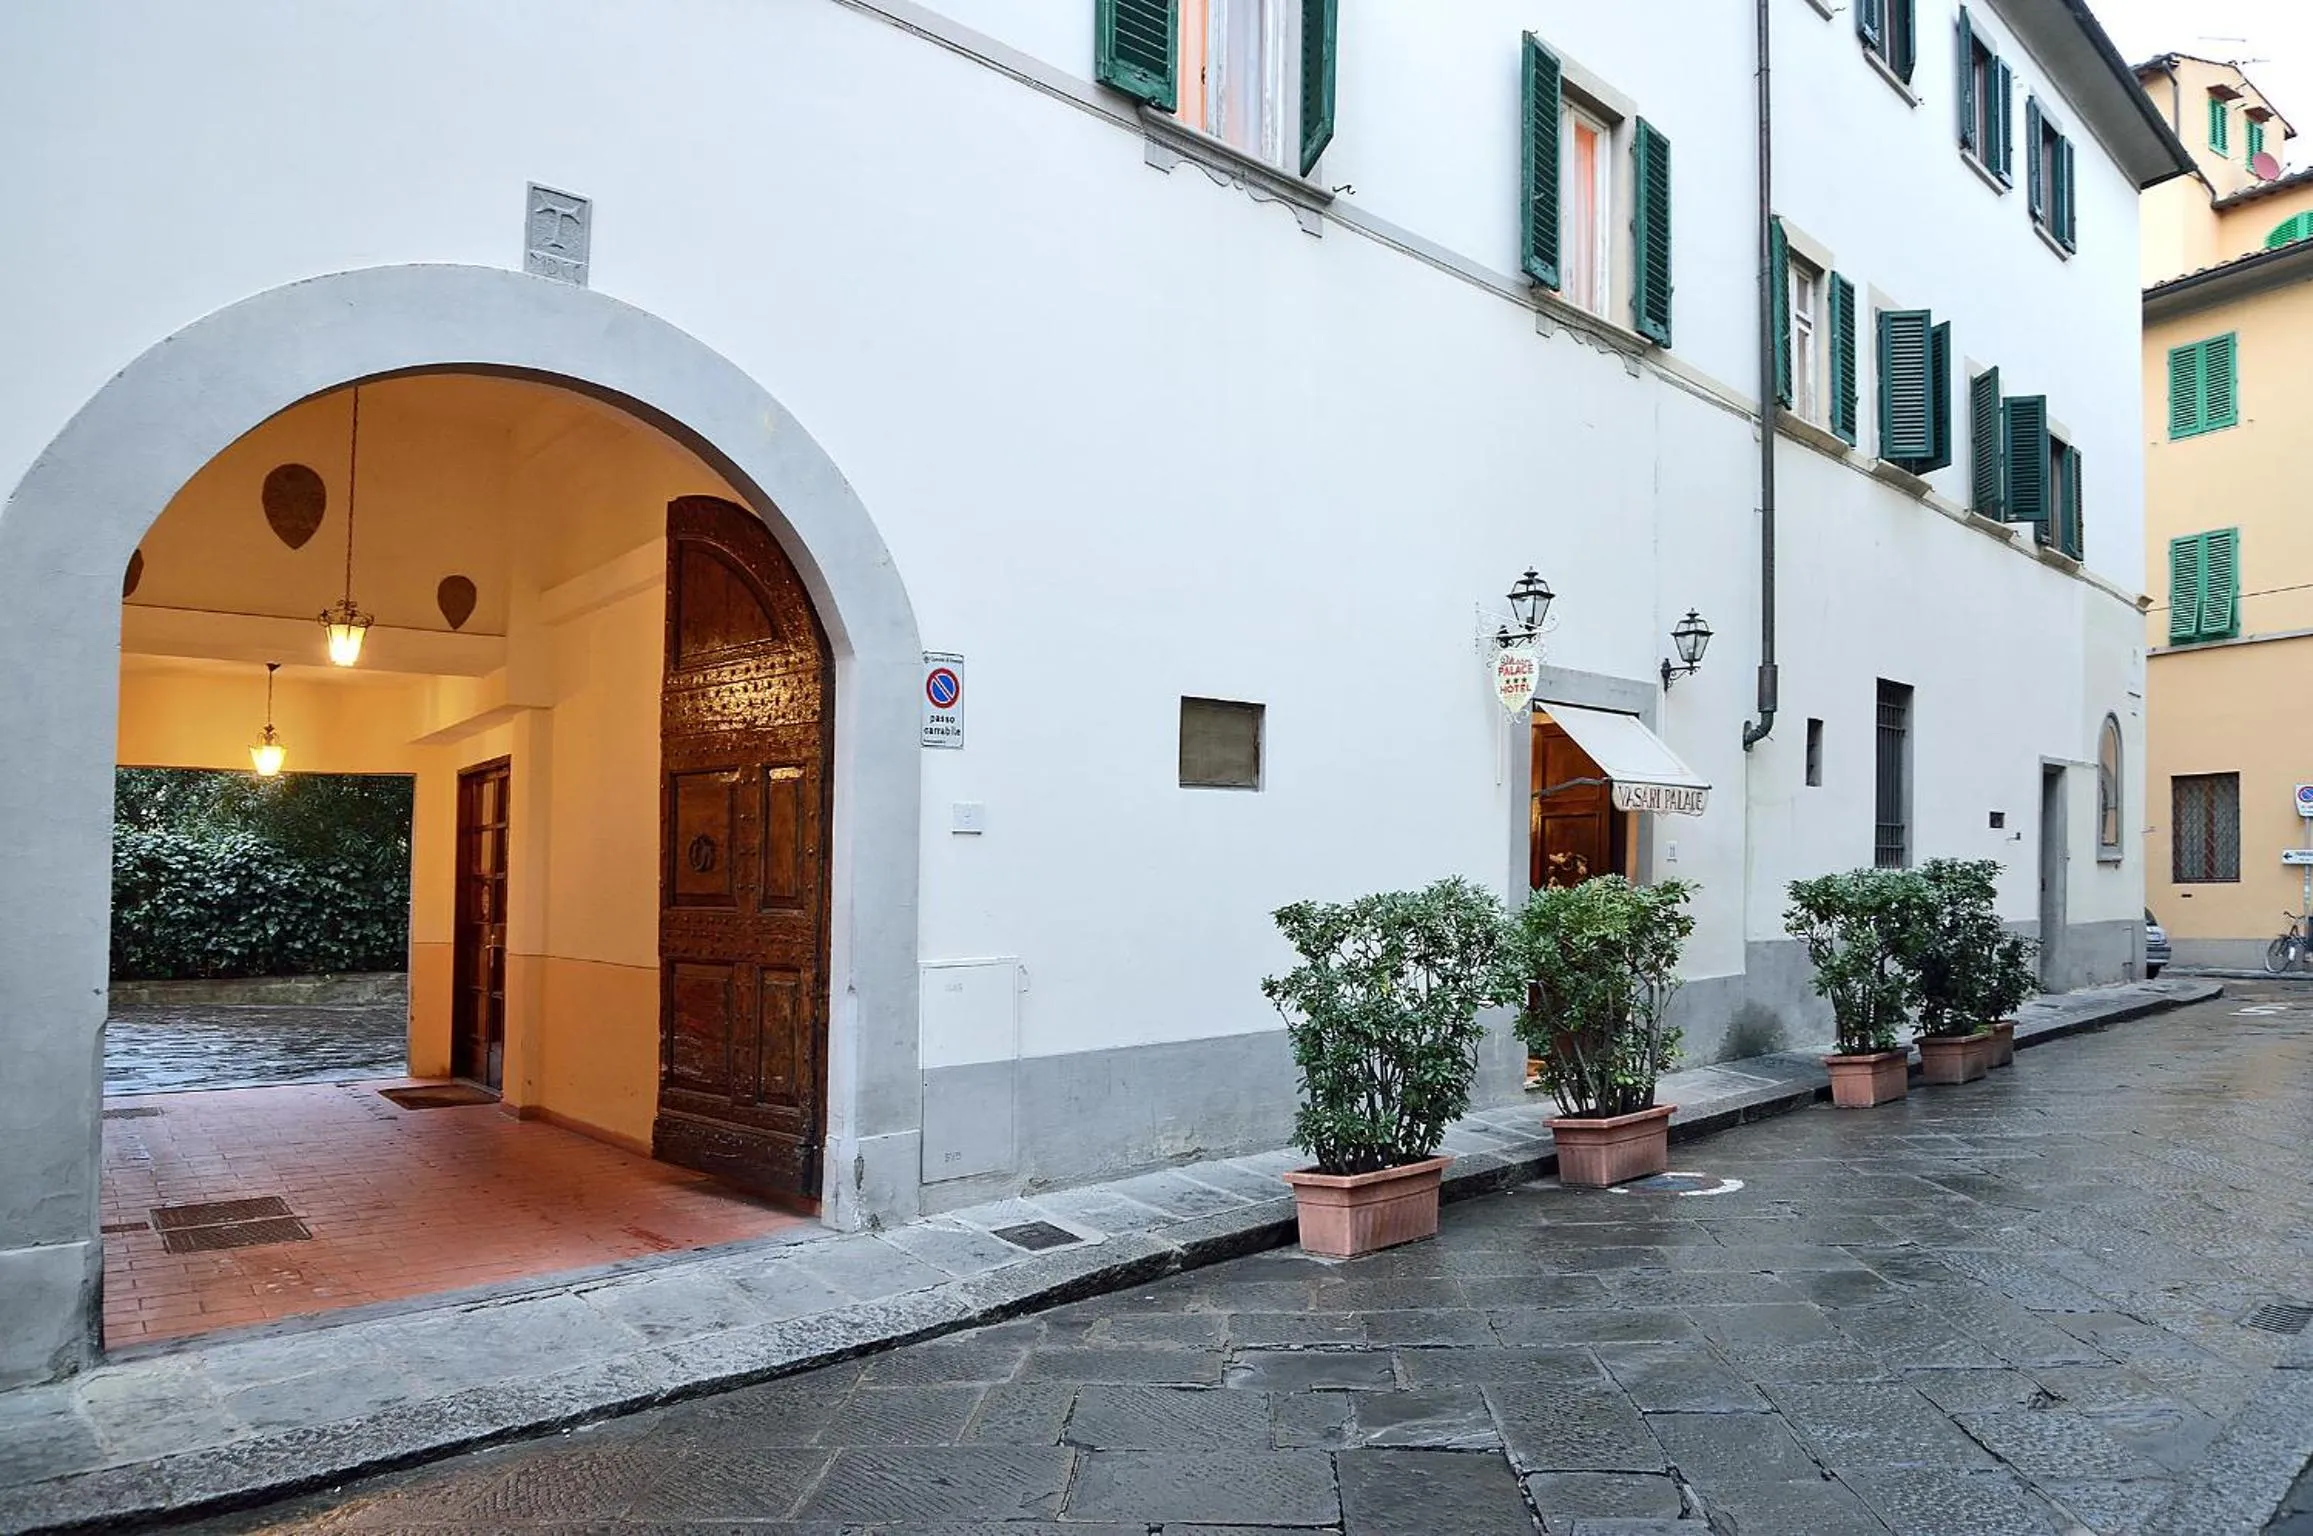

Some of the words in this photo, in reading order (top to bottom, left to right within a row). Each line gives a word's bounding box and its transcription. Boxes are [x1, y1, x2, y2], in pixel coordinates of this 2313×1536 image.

[1498, 663, 1534, 676] PALACE
[1500, 683, 1532, 694] HOTEL
[929, 714, 955, 724] passo
[923, 726, 961, 736] carrabile
[1618, 785, 1661, 809] VASARI
[1664, 788, 1704, 812] PALACE
